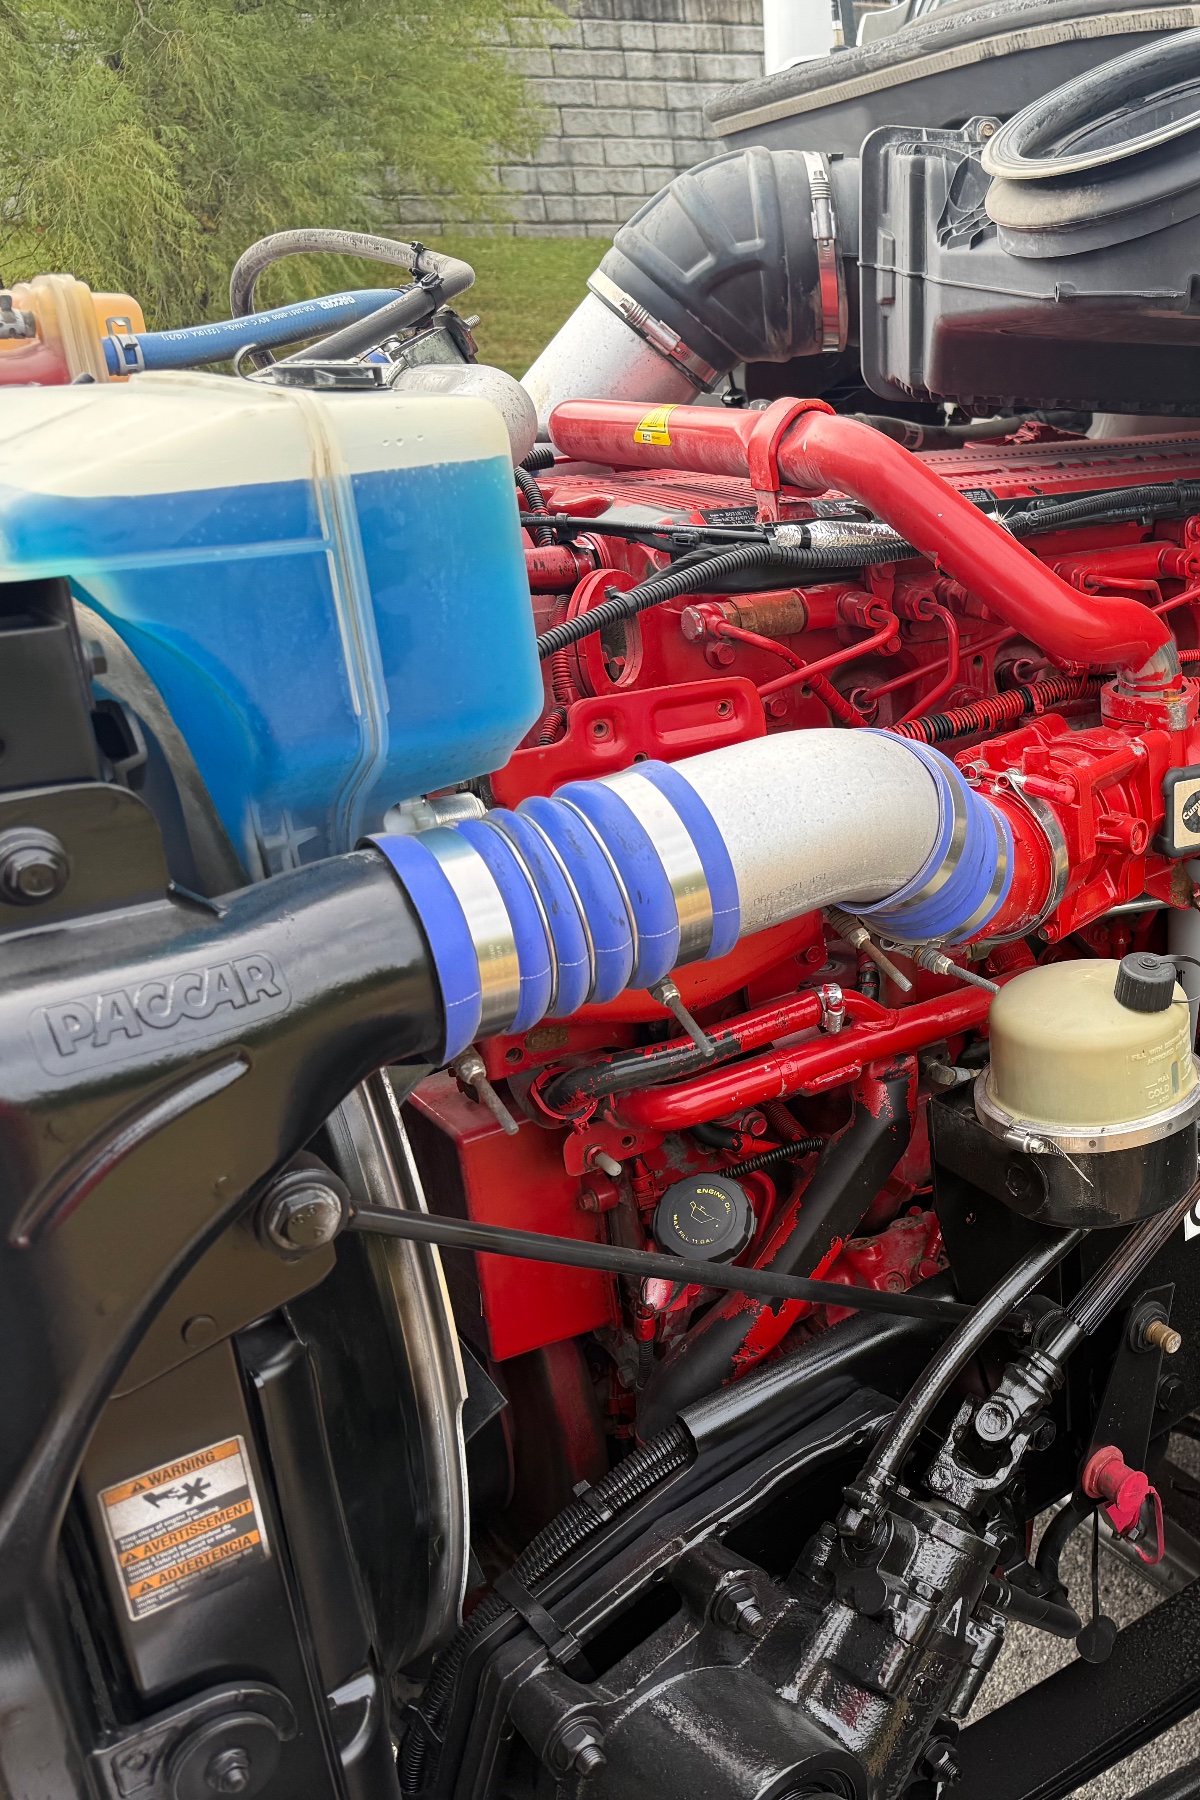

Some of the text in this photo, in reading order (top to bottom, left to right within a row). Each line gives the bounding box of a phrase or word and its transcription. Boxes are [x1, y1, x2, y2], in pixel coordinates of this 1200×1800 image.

[43, 953, 282, 1057] PACCAR
[1148, 1084, 1170, 1100] COLD
[696, 1188, 732, 1215] ENGINE OIL
[678, 1230, 690, 1242] FILL
[700, 1237, 715, 1245] GAL
[147, 1451, 216, 1486] WARNING
[143, 1501, 251, 1555] AVERTISSEMENT
[158, 1535, 253, 1582] ADVERTENCIA
